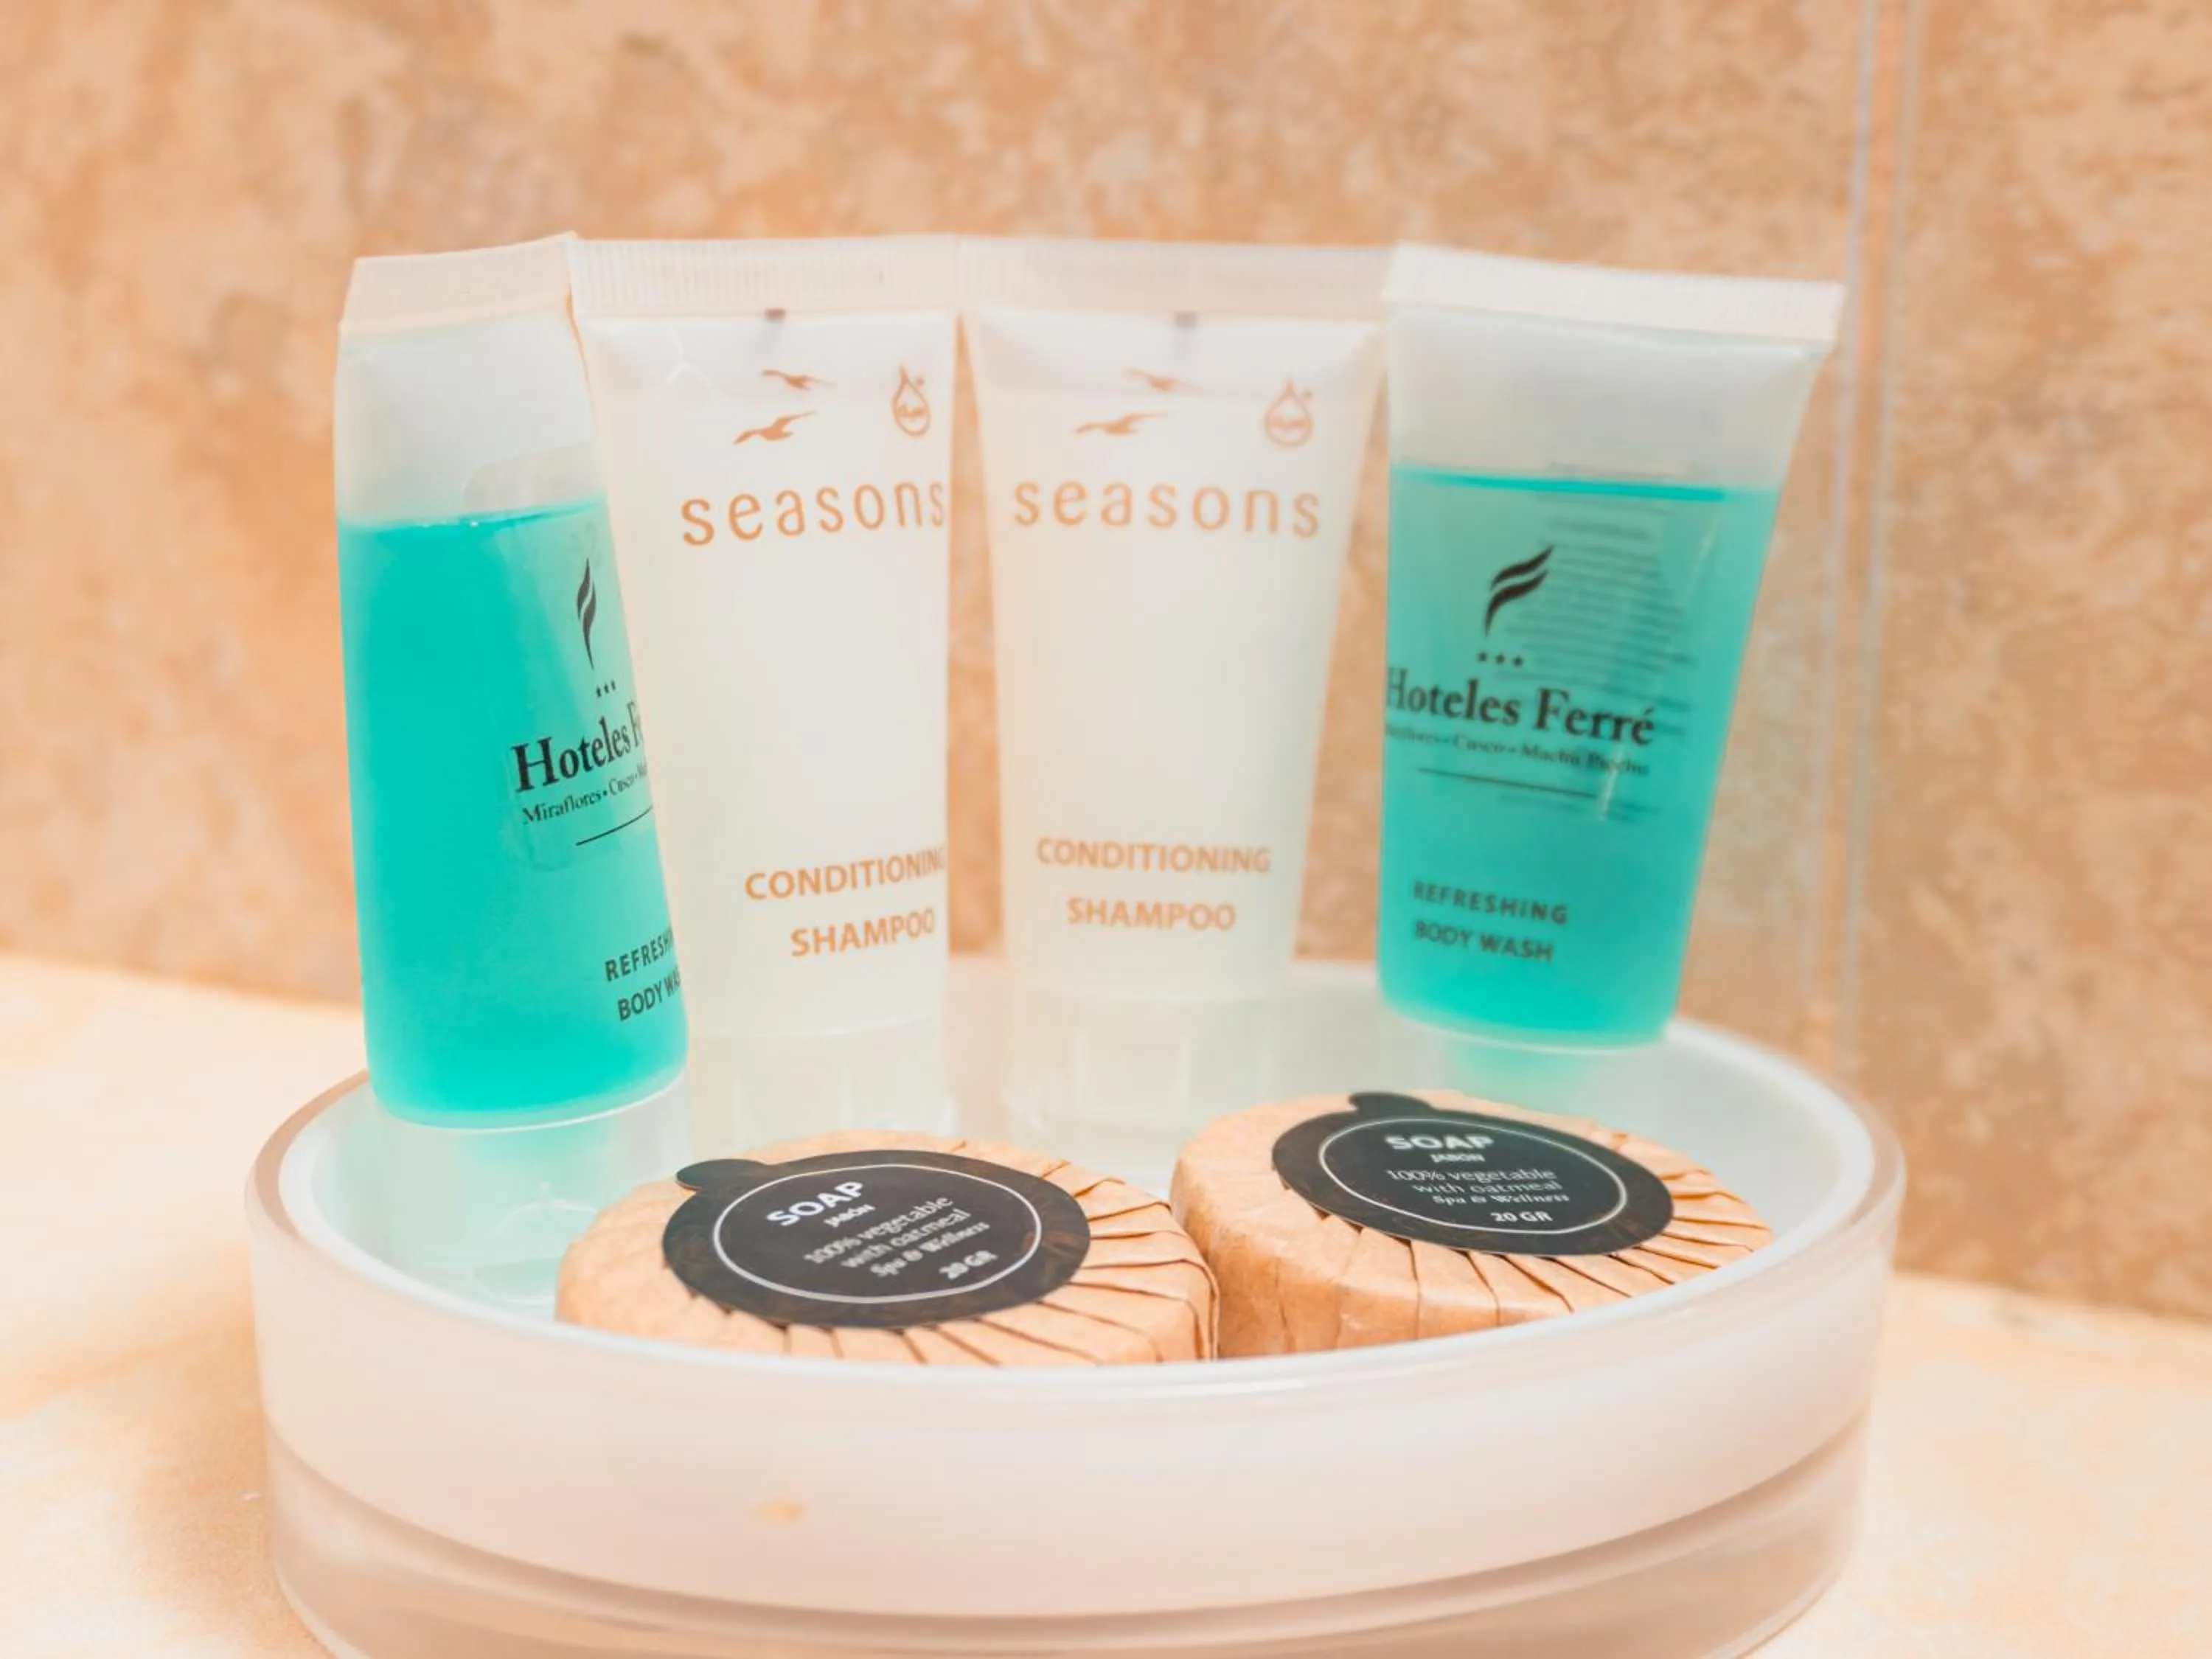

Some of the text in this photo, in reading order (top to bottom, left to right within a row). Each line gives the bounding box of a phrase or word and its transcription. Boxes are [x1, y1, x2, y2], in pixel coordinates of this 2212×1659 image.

[681, 481, 945, 546] seasons
[1013, 481, 1321, 539] seasons
[1386, 667, 1655, 747] Hoteles Ferré
[511, 716, 631, 793] Hoteles
[522, 791, 602, 824] Miraflores
[1036, 838, 1272, 873] CONDITIONING
[1066, 896, 1238, 931] SHAMPOO
[1413, 880, 1568, 926] REFRESHING
[790, 907, 935, 957] SHAMPOO
[1415, 919, 1554, 962] BODY WASH
[617, 981, 663, 1021] BODY
[1385, 1133, 1495, 1150] SOAP
[1386, 1169, 1558, 1183] 100% vegetable
[1411, 1181, 1563, 1194] with oatmeal
[767, 1181, 863, 1227] SOAP
[857, 1197, 954, 1240] vegetable
[1489, 1211, 1554, 1222] 20 GR
[889, 1208, 972, 1248] oatmeal
[939, 1262, 970, 1280] 20
